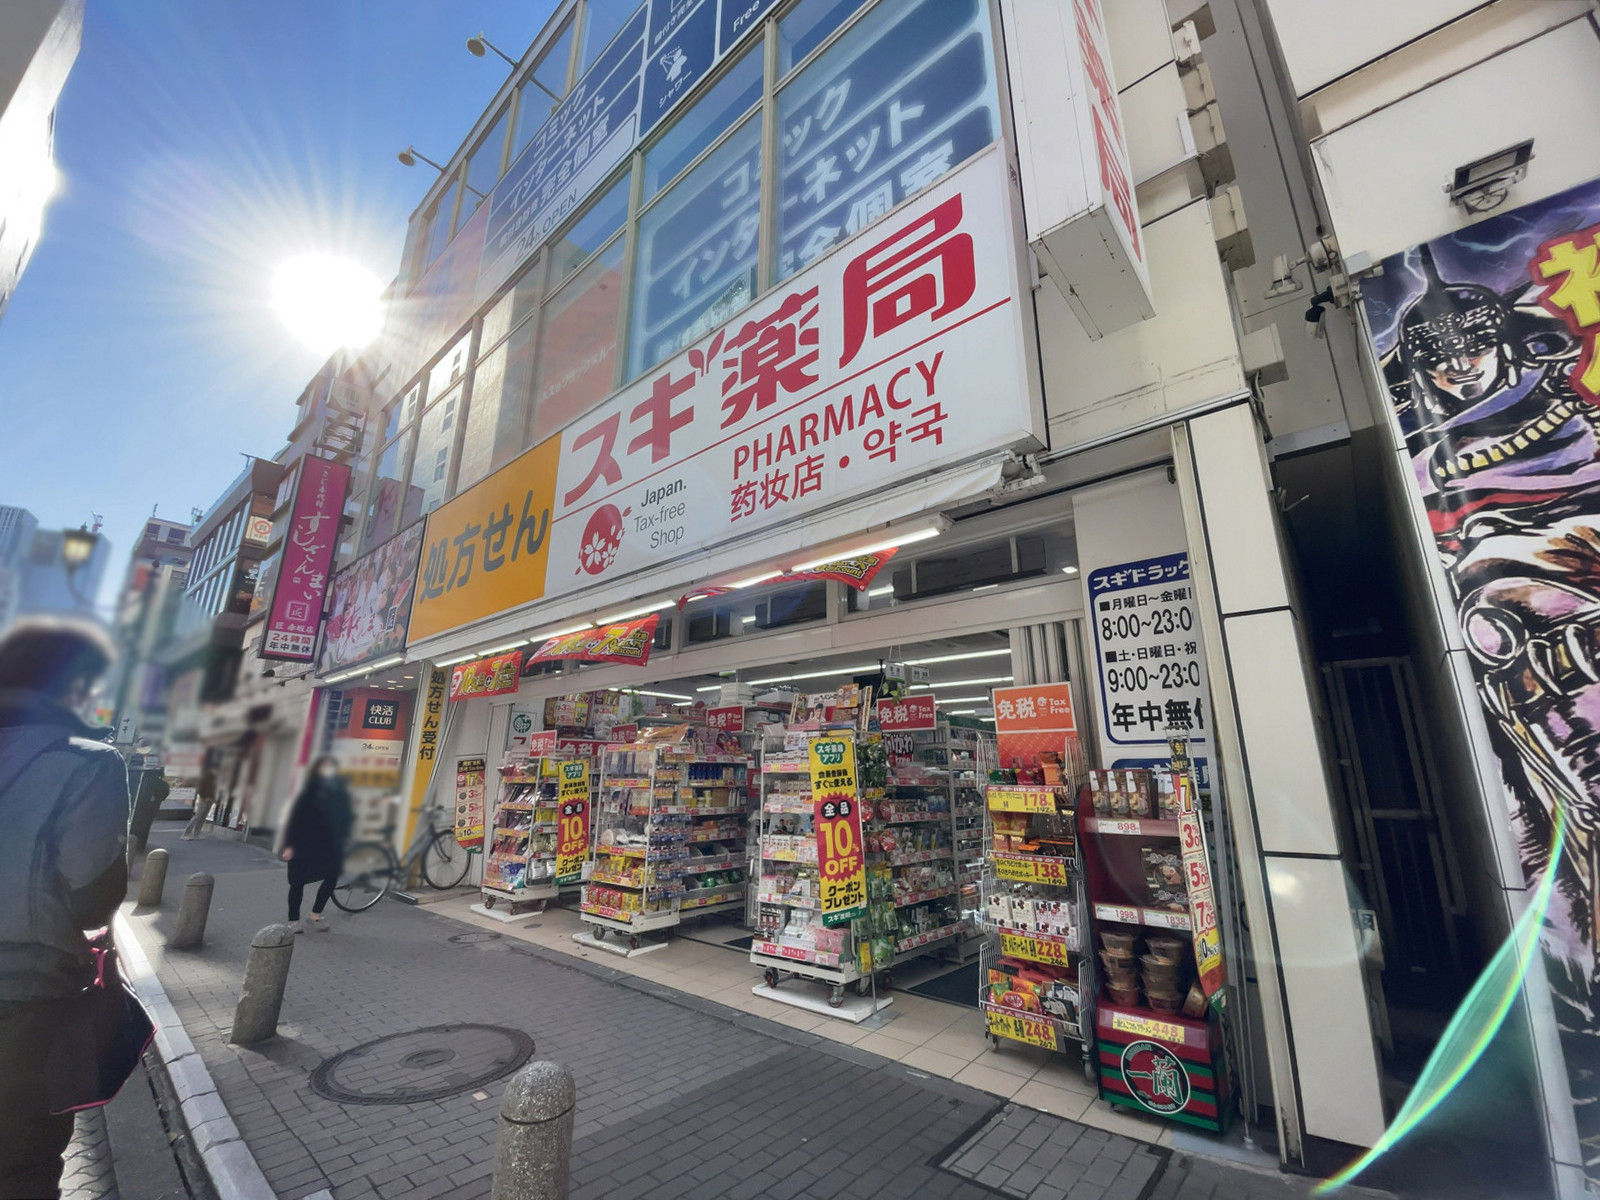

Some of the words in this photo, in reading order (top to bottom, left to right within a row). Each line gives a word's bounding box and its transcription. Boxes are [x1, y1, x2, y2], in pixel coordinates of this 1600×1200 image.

[658, 70, 692, 109] シャワー
[533, 83, 587, 158] コミック
[508, 95, 606, 212] インターネット
[720, 78, 852, 210] コック
[539, 112, 610, 202] 完全個室
[541, 188, 578, 233] OPEN
[563, 191, 978, 509] スギ薬局
[733, 349, 945, 481] PHARMACY
[730, 456, 824, 524] 药妆店
[862, 402, 949, 465] 약국
[640, 478, 688, 509] Japan.
[633, 500, 686, 531] Tax-free
[418, 489, 550, 605] 処方せん
[649, 525, 684, 550] Shop
[292, 511, 332, 601] すしざんまい
[1112, 587, 1192, 611] 月曜日～金曜
[1101, 606, 1193, 642] 8:00~23:0
[269, 641, 311, 654] 年中無休
[272, 633, 312, 645] 24時間
[370, 704, 394, 717] 快活
[418, 671, 446, 761] 処方せん受付
[880, 704, 909, 723] 免税
[918, 705, 931, 713] Tax
[997, 697, 1037, 720] 免税
[1048, 698, 1067, 706] Tax
[1050, 706, 1071, 714] Free
[368, 716, 392, 725] CLUB
[708, 713, 727, 728] 免税
[817, 743, 844, 754] スギ薬局
[822, 753, 841, 763] アプリ
[814, 777, 853, 791] すぐに使える
[822, 799, 850, 819] 全品
[1022, 792, 1048, 807] 178
[564, 803, 583, 816] 全品
[1117, 822, 1136, 831] 898
[561, 839, 584, 853] OFF
[558, 864, 583, 876] プレゼン
[562, 855, 585, 869] クーポン
[824, 859, 858, 876] OFF
[1032, 861, 1060, 879] 138
[827, 881, 861, 901] クーポン
[824, 892, 865, 911] プレゼント
[1115, 909, 1135, 919] 1998
[1165, 915, 1186, 926] 1838
[1037, 940, 1063, 959] 228
[1024, 1020, 1050, 1041] 248
[1152, 1022, 1179, 1038] 448
[1125, 1055, 1184, 1105] 一蘭
